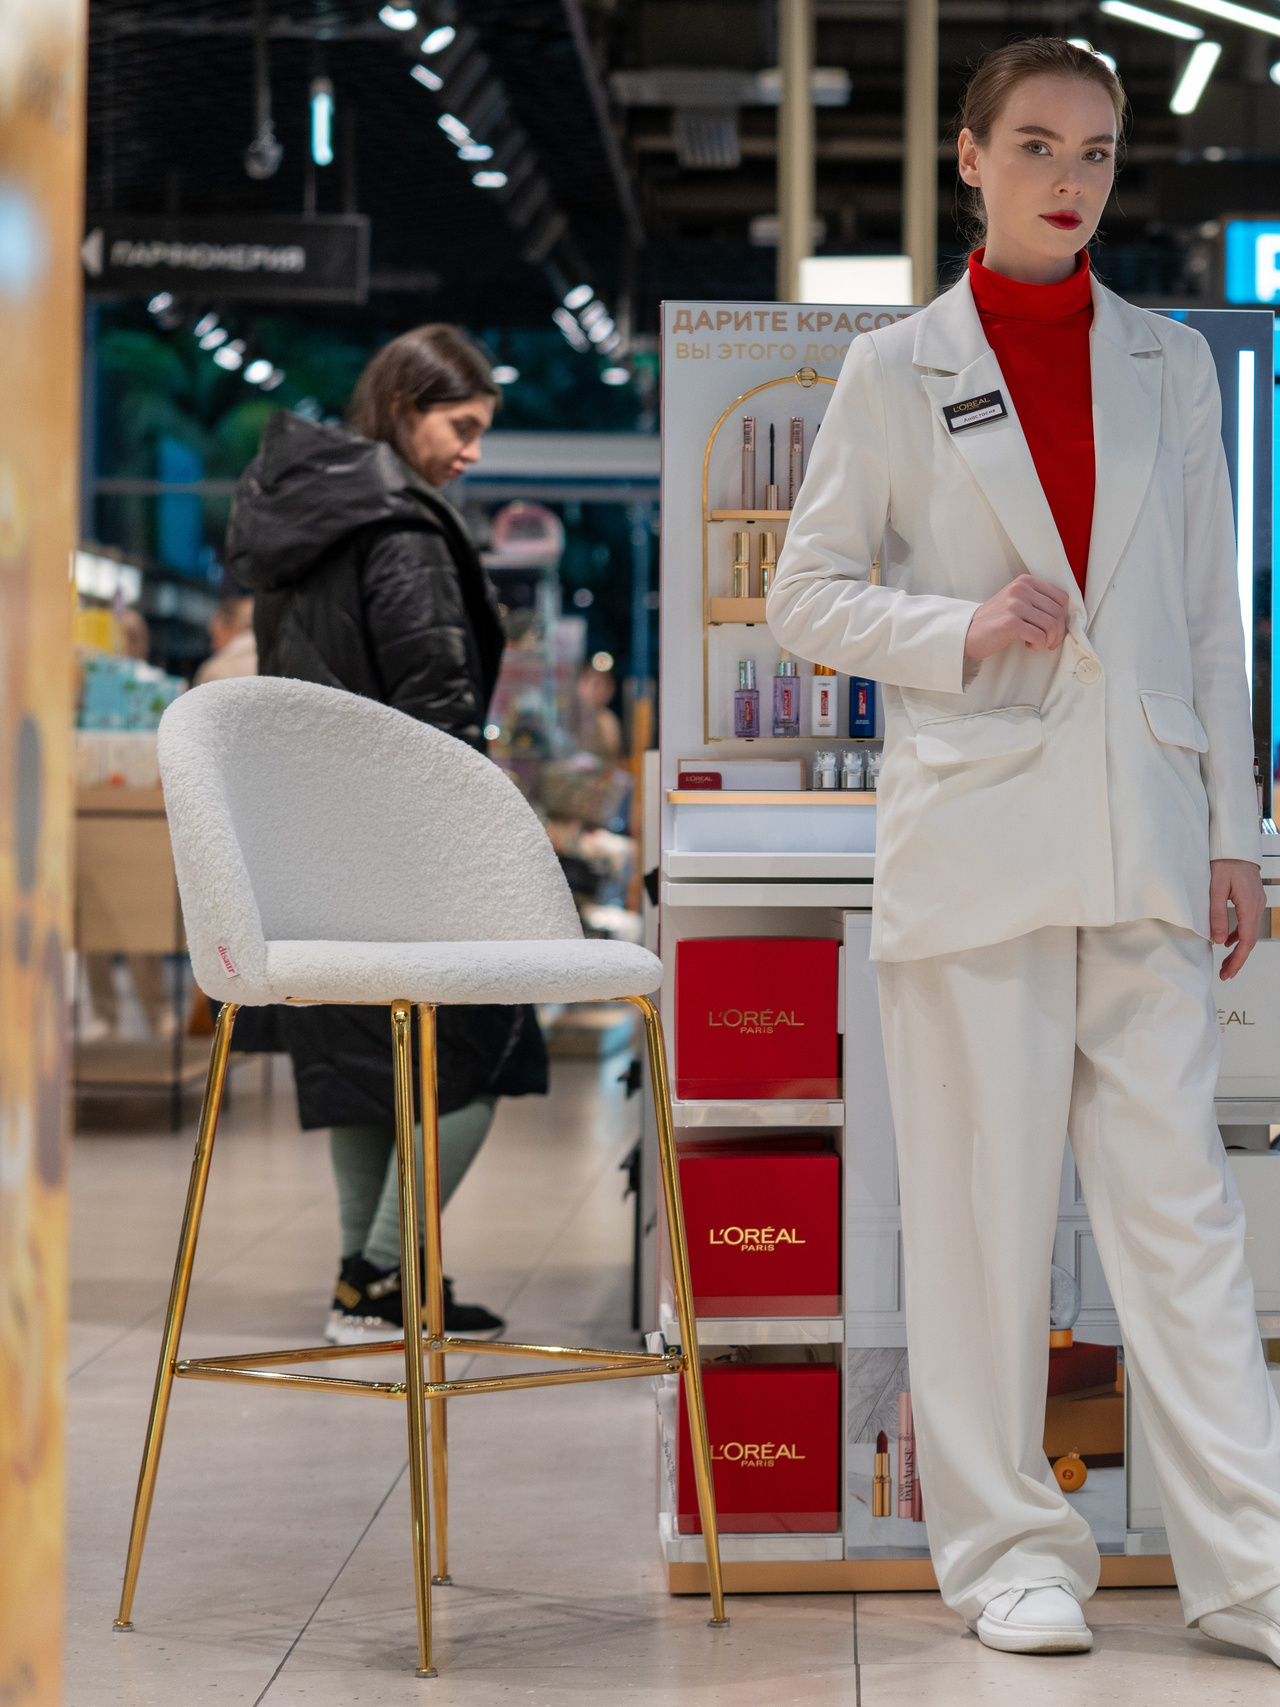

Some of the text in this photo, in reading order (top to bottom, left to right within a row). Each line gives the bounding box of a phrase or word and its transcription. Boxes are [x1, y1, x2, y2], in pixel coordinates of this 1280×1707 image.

[672, 310, 787, 334] ДАРИТЕ
[676, 343, 710, 360] ВЫ
[718, 343, 797, 360] ЭТОГО
[708, 1009, 804, 1027] L'ORÉAL
[709, 1226, 806, 1245] L'ORÉAL
[710, 1442, 806, 1461] L'ORÉAL
